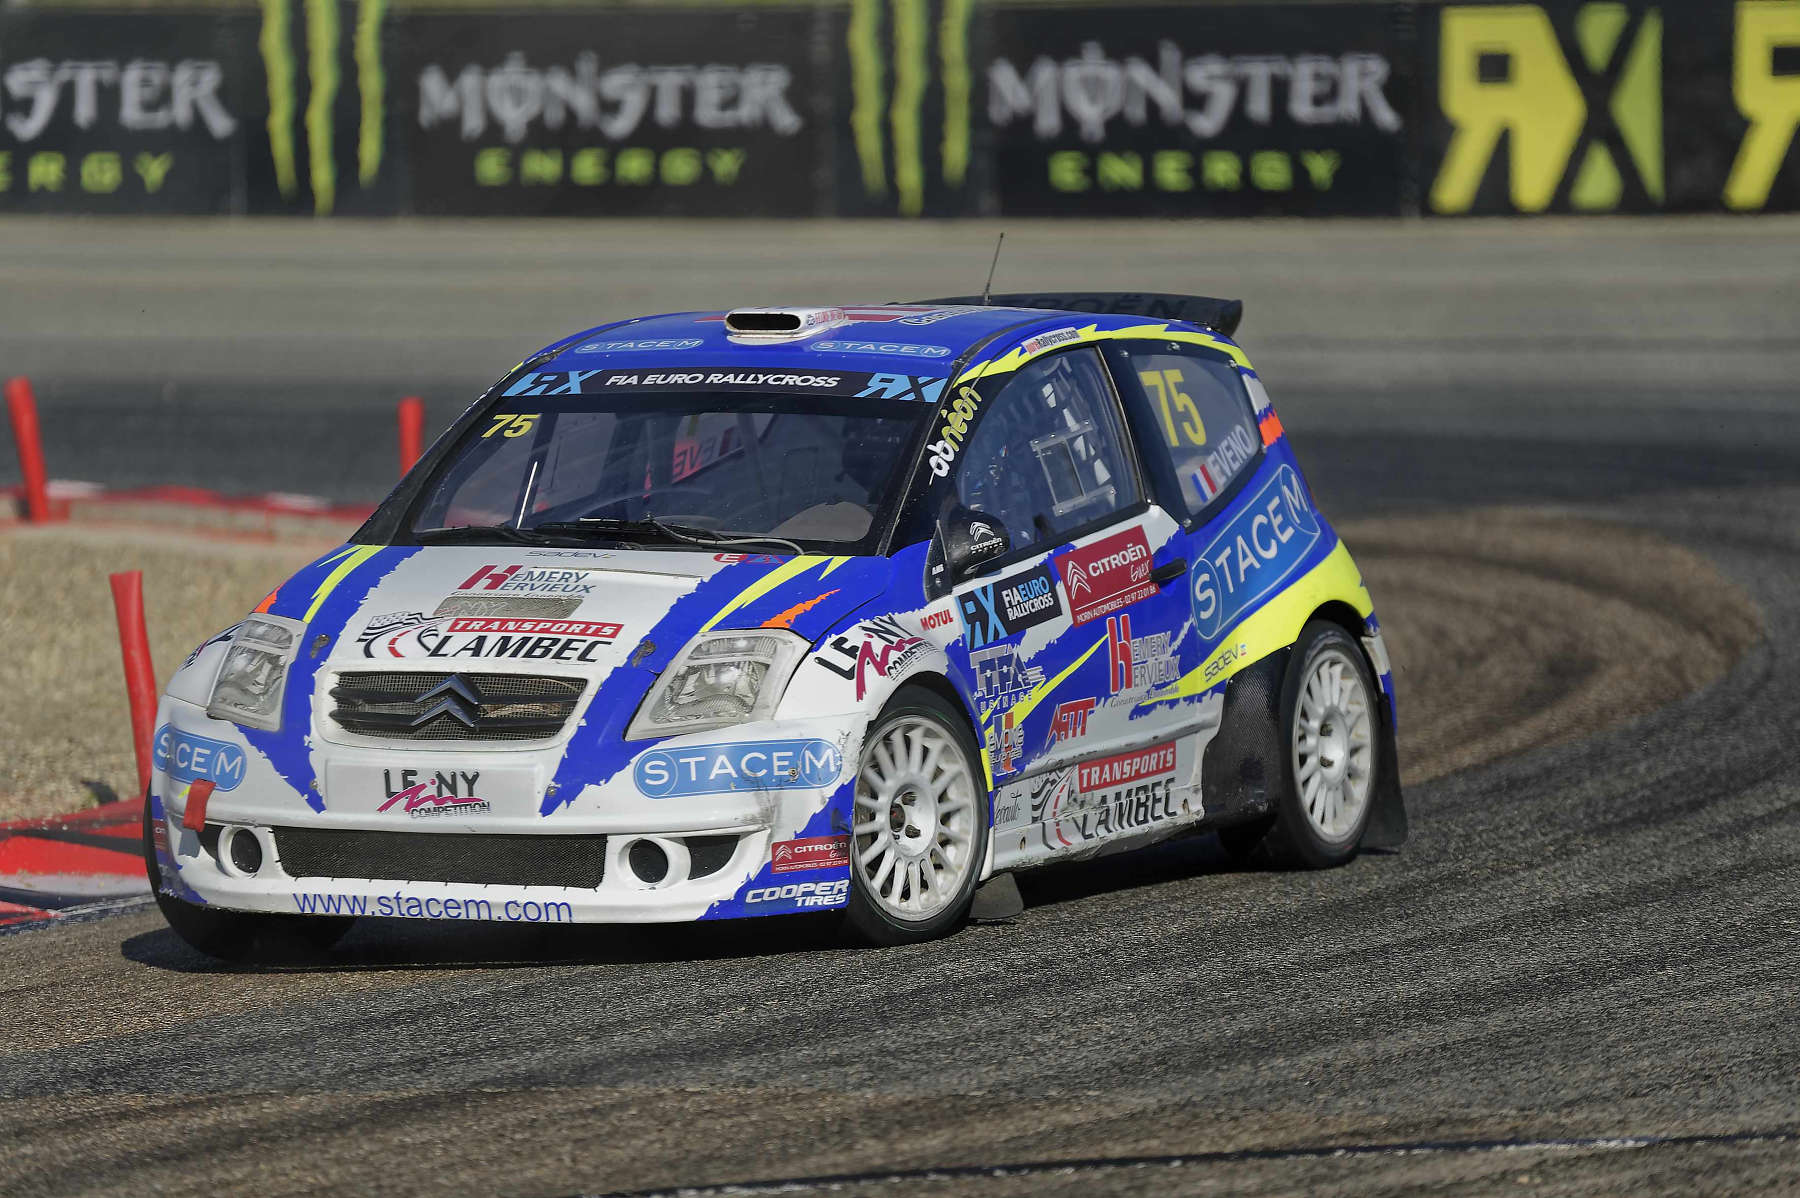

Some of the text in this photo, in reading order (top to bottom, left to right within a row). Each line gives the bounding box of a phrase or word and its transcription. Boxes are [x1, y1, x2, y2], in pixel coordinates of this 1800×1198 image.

[418, 50, 801, 141] MONSTER
[987, 40, 1403, 142] MONSTER
[473, 147, 745, 187] ENERGY
[1048, 149, 1342, 192] ENERGY
[584, 339, 700, 352] STACEM
[818, 342, 949, 356] STACEM
[604, 373, 841, 388] FIA EURO RALLYCROSS
[1139, 369, 1207, 447] 75
[481, 413, 542, 438] 75
[1207, 424, 1251, 484] EVENO
[1195, 474, 1309, 620] STACEM
[920, 608, 954, 632] MOTUL
[1007, 591, 1055, 621] RALLYCROSS
[453, 619, 617, 637] TRANSPORTS
[427, 635, 613, 663] LAMBEC
[644, 750, 838, 786] STACEM
[1080, 748, 1175, 789] TRANSPORTS
[292, 890, 574, 923] www.stacem.com
[745, 879, 850, 904] COOPER
[795, 892, 847, 907] TIRES
